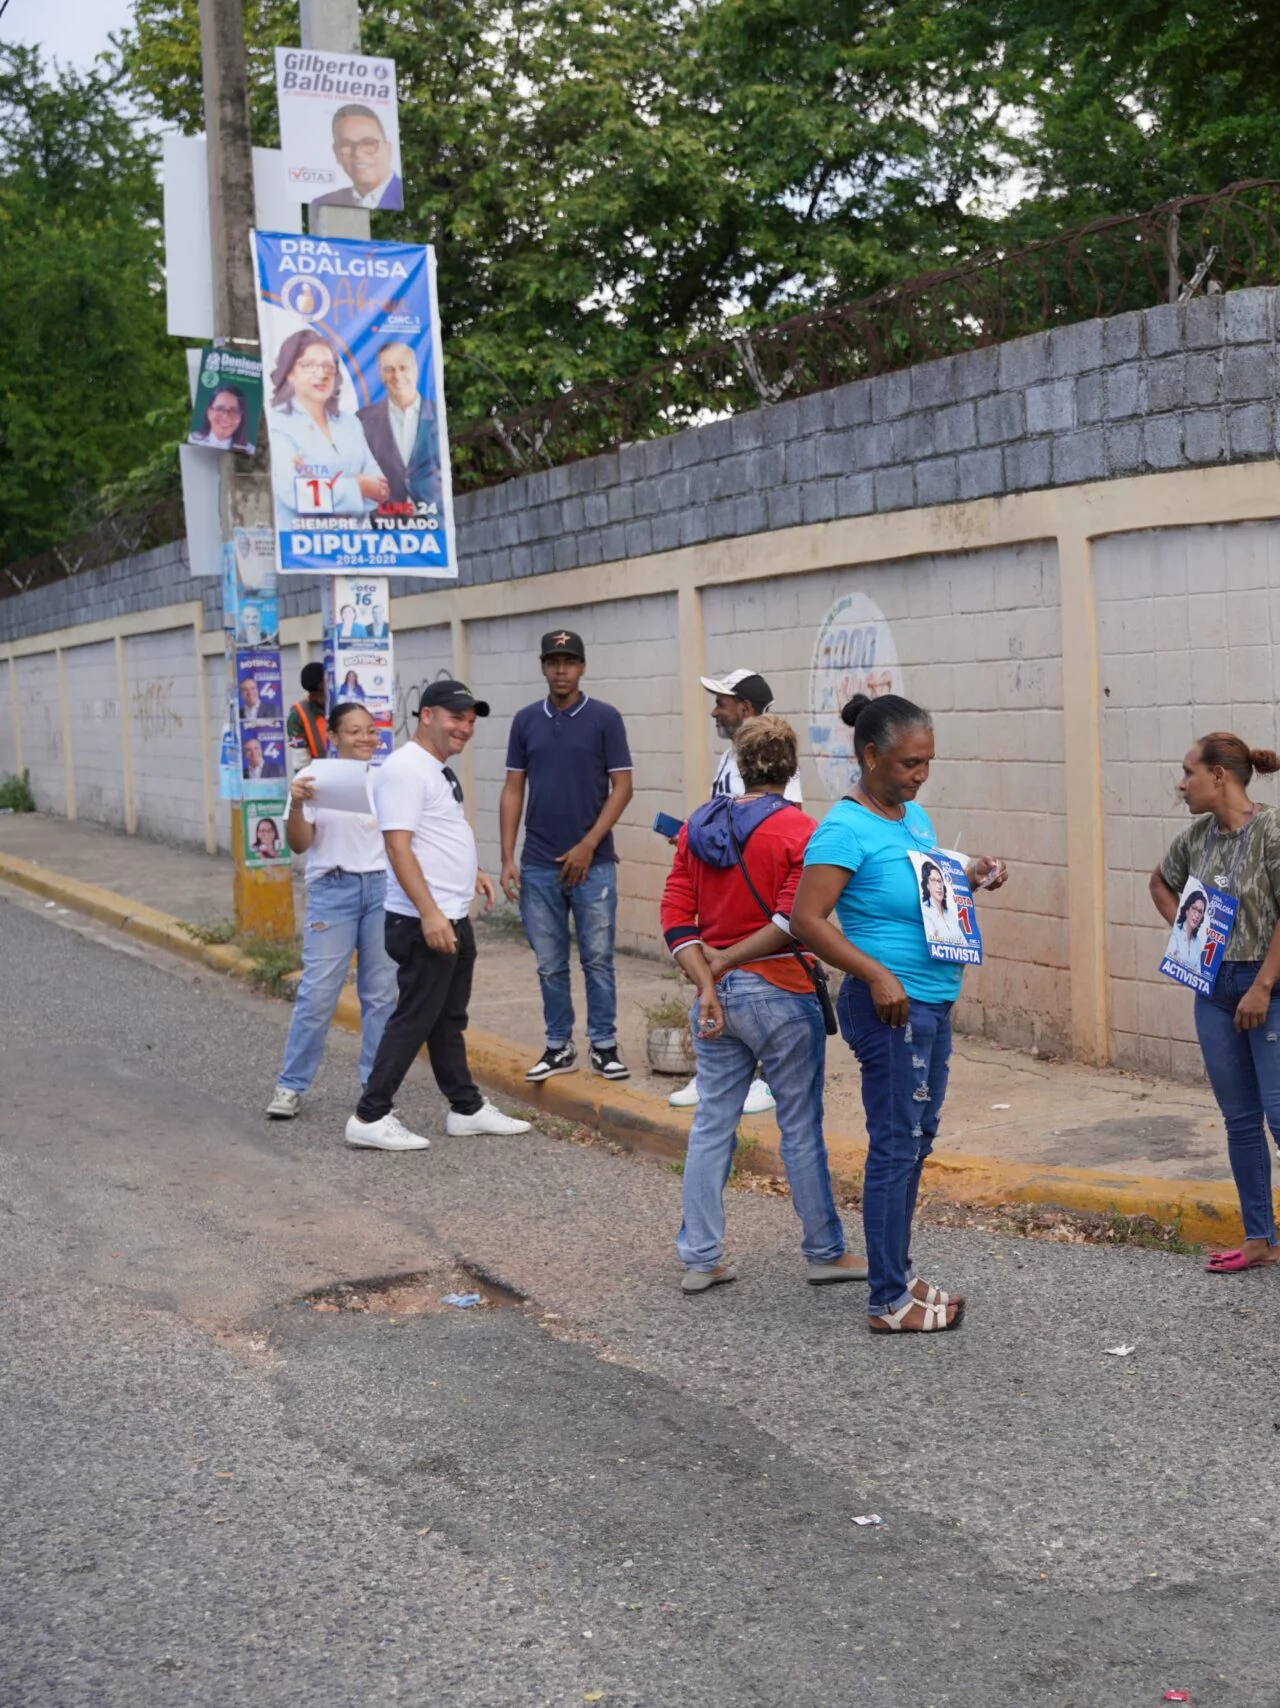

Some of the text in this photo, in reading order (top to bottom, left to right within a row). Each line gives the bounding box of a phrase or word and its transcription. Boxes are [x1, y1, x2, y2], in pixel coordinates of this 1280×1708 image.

[284, 53, 368, 78] Gilberto
[283, 71, 390, 98] Balbuena
[281, 240, 340, 256] DRA.
[278, 255, 408, 278] ADALGISA
[295, 465, 329, 476] VOTA
[306, 480, 320, 508] 1
[417, 501, 438, 515] 24
[292, 518, 357, 530] SIEMPRE
[375, 518, 395, 530] TU
[397, 518, 438, 530] LADO
[290, 534, 441, 555] DIPUTADA
[336, 554, 397, 565] 2024-2028
[355, 592, 372, 606] 16
[952, 895, 972, 906] VOTA
[957, 907, 973, 934] 1
[1206, 928, 1225, 944] VOTA
[931, 945, 980, 963] ACTIVISTA
[1203, 941, 1217, 967] 1
[1161, 960, 1210, 994] ACTIVISTA
